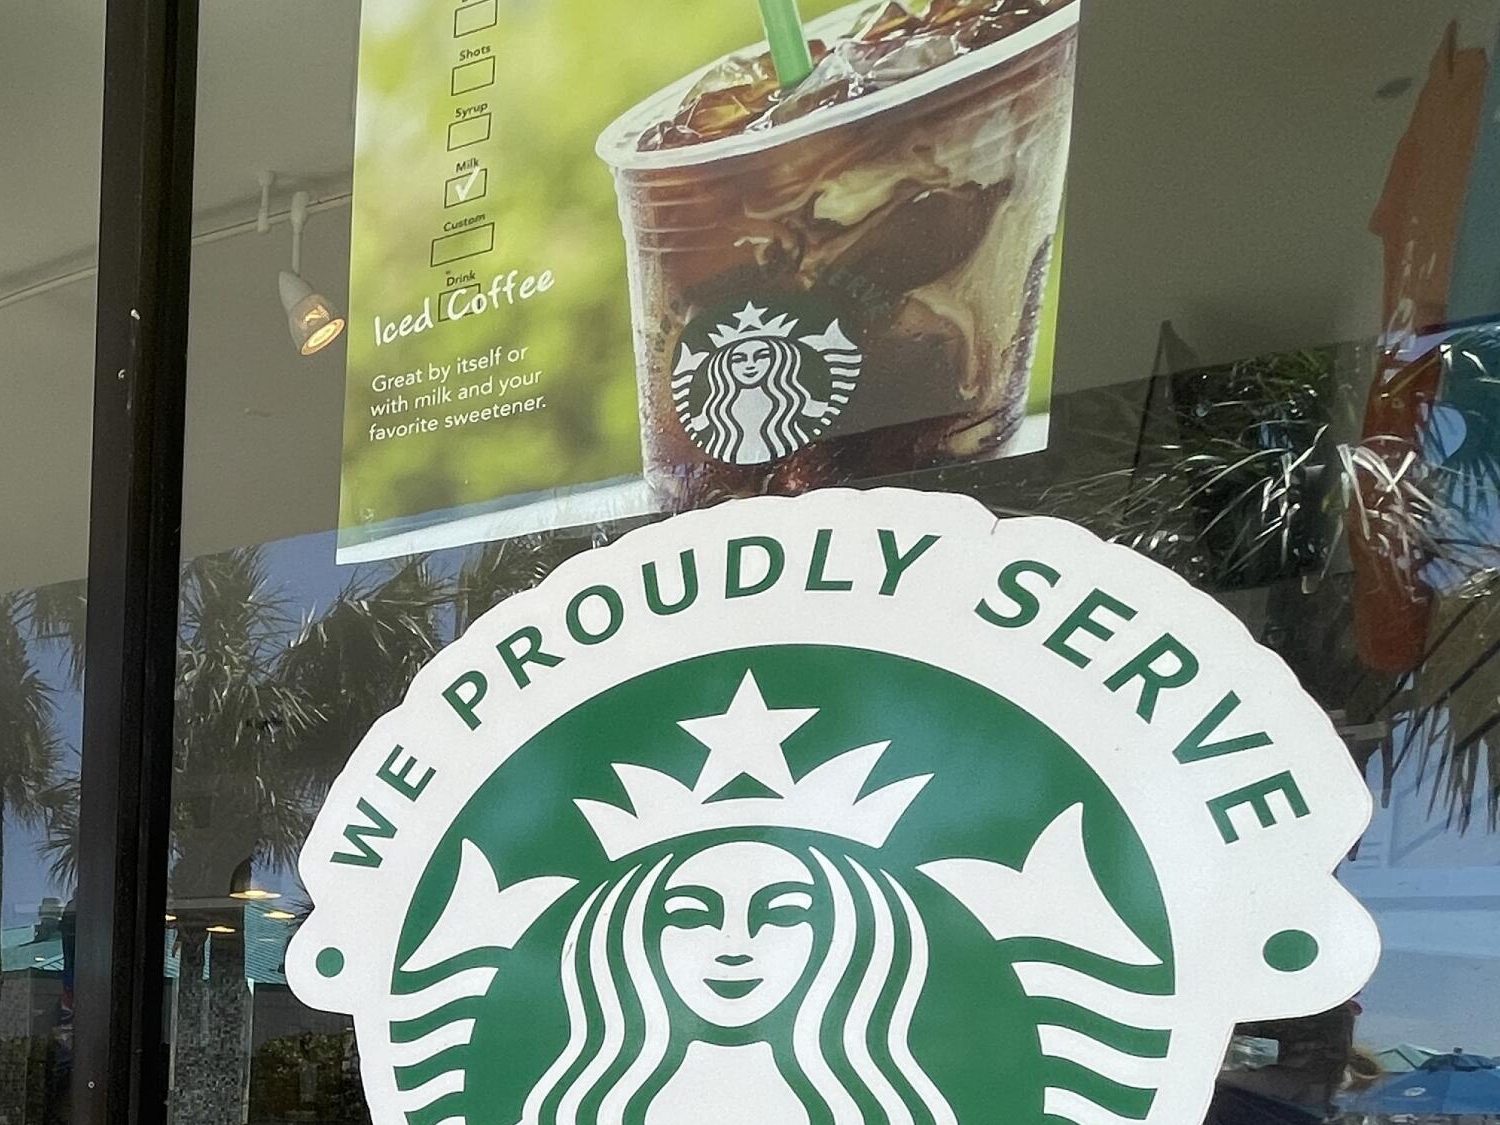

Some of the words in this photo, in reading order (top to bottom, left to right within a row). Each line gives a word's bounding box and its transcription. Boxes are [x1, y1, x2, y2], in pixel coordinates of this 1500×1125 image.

[459, 44, 491, 61] Shots
[455, 102, 488, 119] Syrup
[456, 158, 480, 173] Milk
[443, 213, 486, 232] Custom
[446, 270, 476, 287] Drink
[374, 297, 434, 347] Iced
[447, 269, 555, 321] Coffee
[371, 369, 423, 392] Great
[428, 363, 451, 383] by
[456, 346, 502, 375] itself
[507, 346, 529, 363] or
[370, 395, 408, 417] with
[414, 387, 452, 409] milk
[457, 376, 493, 400] and
[499, 370, 542, 396] your
[369, 417, 439, 442] favorite
[444, 394, 547, 428] sweetener.
[330, 744, 437, 873] WE
[440, 528, 943, 733] PROUDLY
[973, 557, 1312, 848] SERVE
